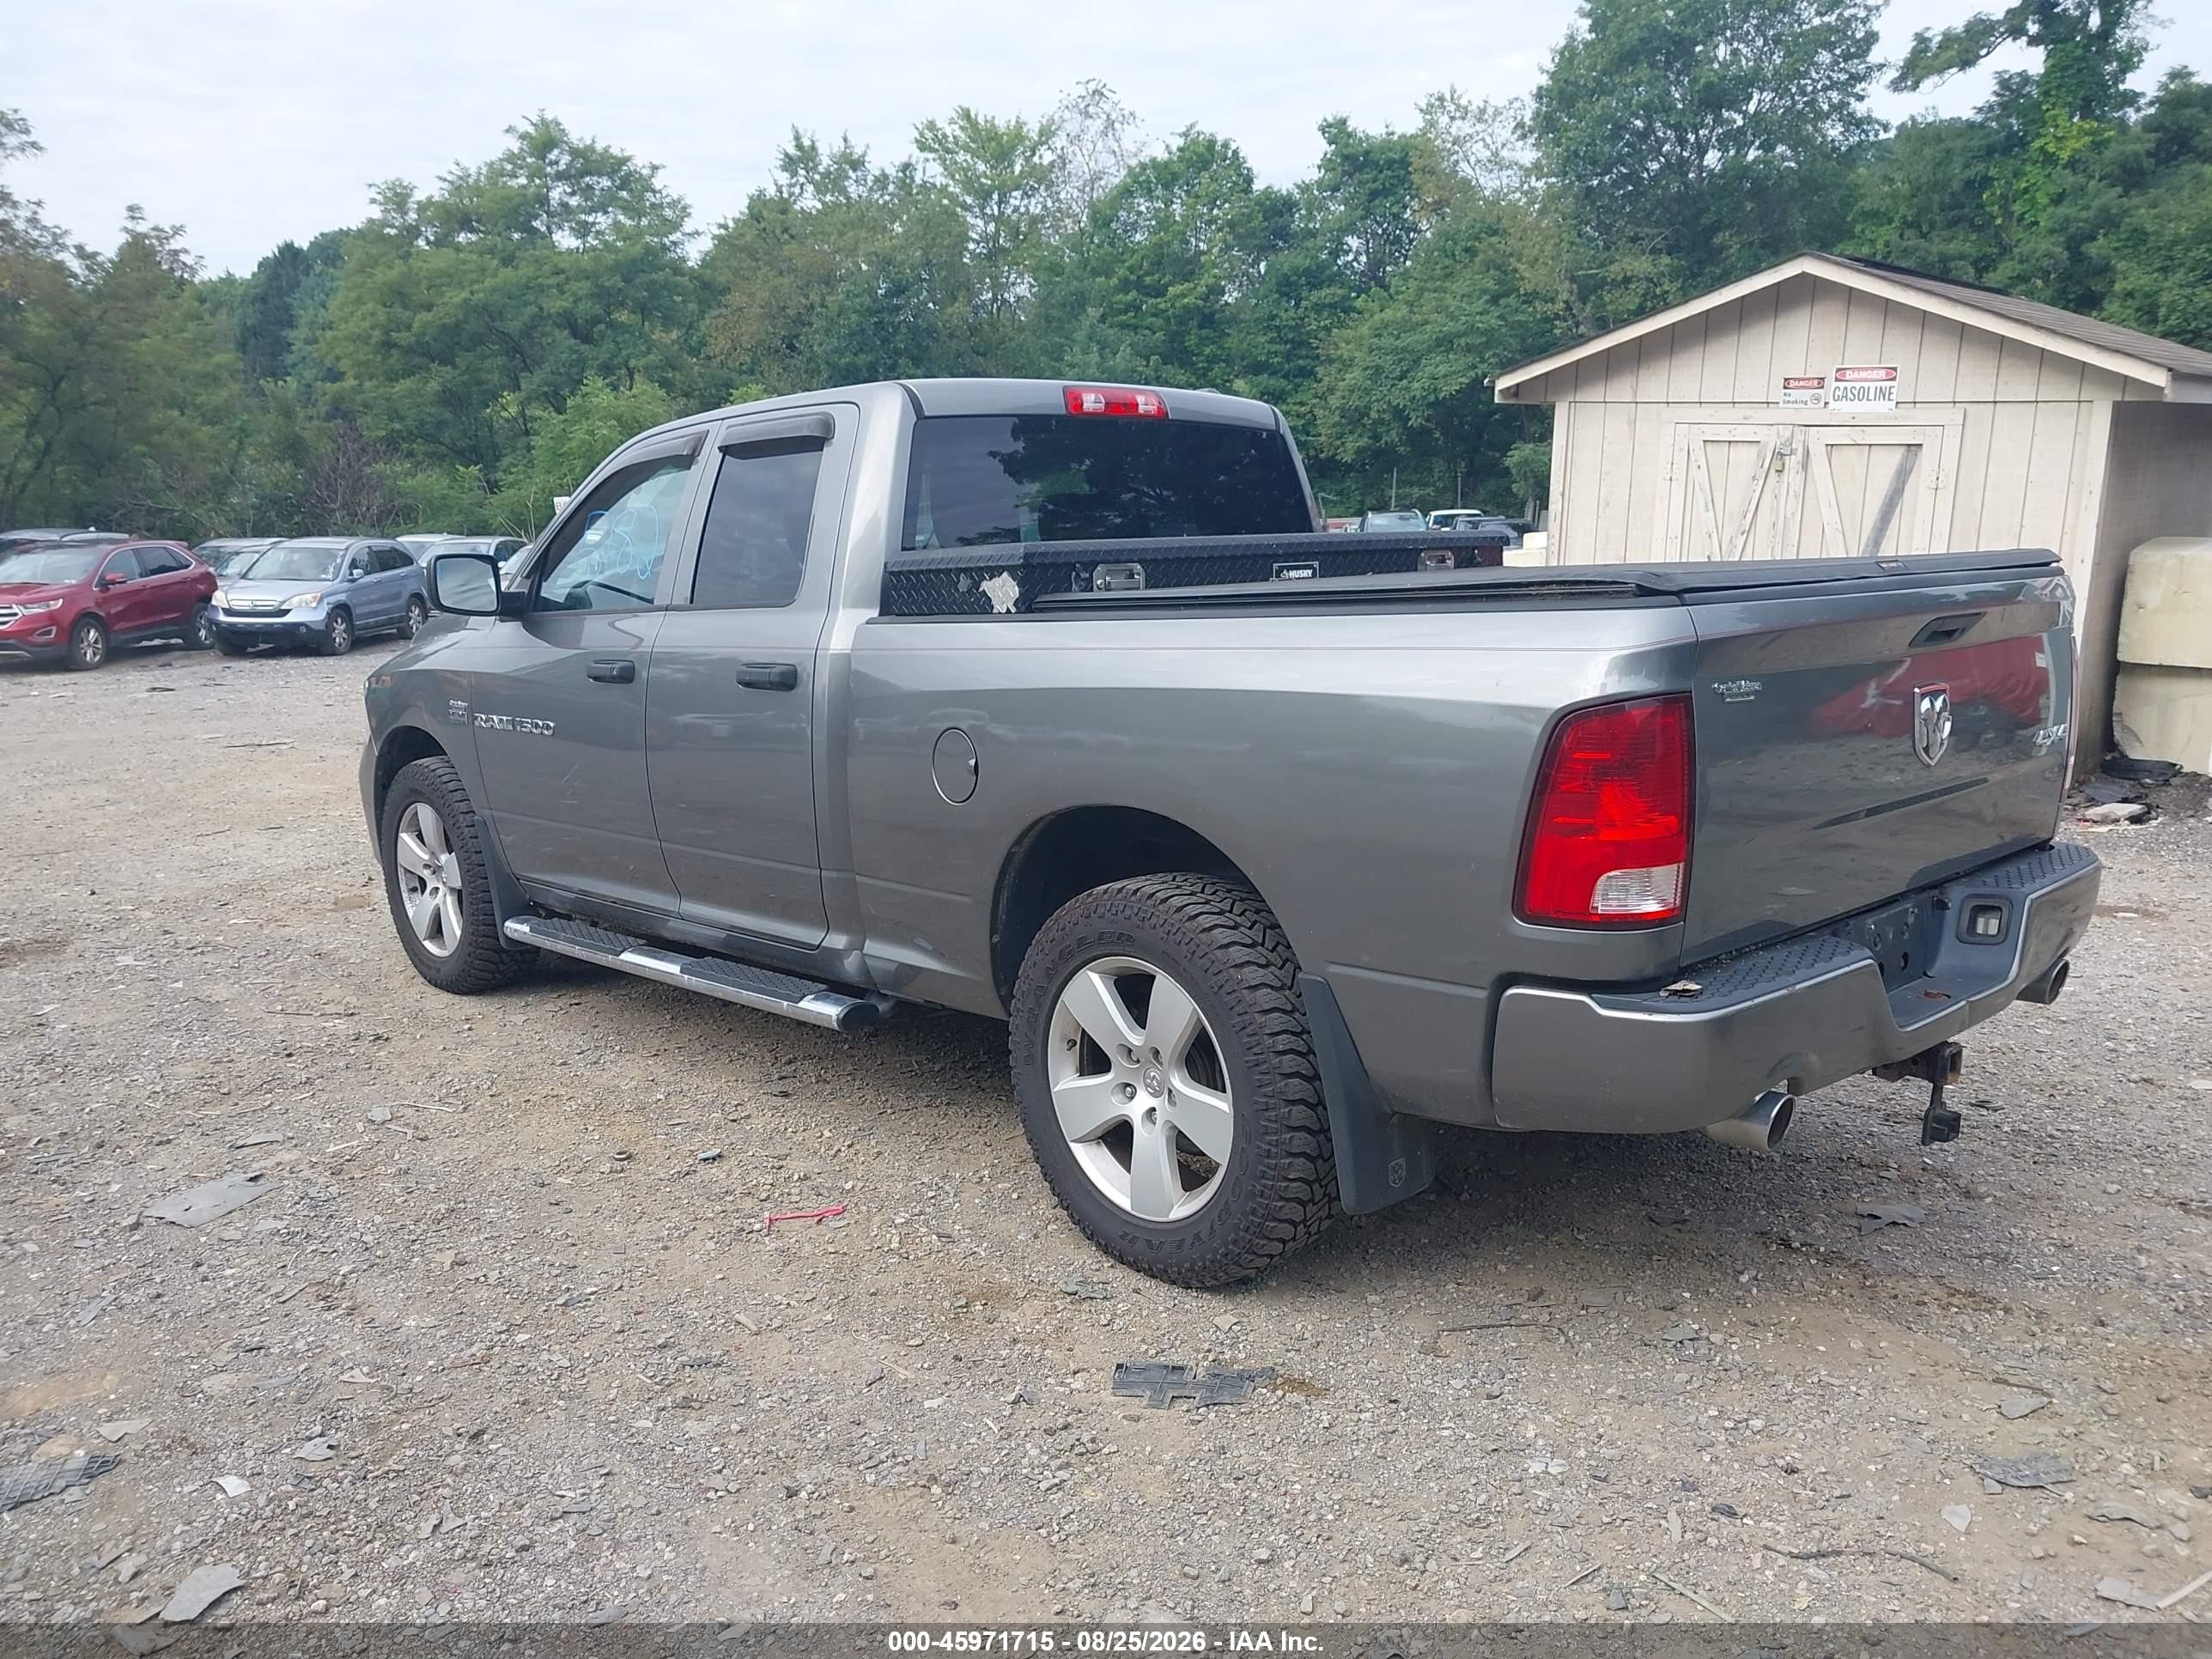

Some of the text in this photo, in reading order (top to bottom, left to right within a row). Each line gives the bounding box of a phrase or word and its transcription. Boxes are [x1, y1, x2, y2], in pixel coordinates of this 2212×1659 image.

[1844, 369, 1887, 380] DANGER
[1790, 379, 1819, 387] DANGER
[1832, 386, 1896, 402] GASOLINE
[1289, 568, 1313, 579] HUSKY
[473, 713, 556, 736] RAM 1500
